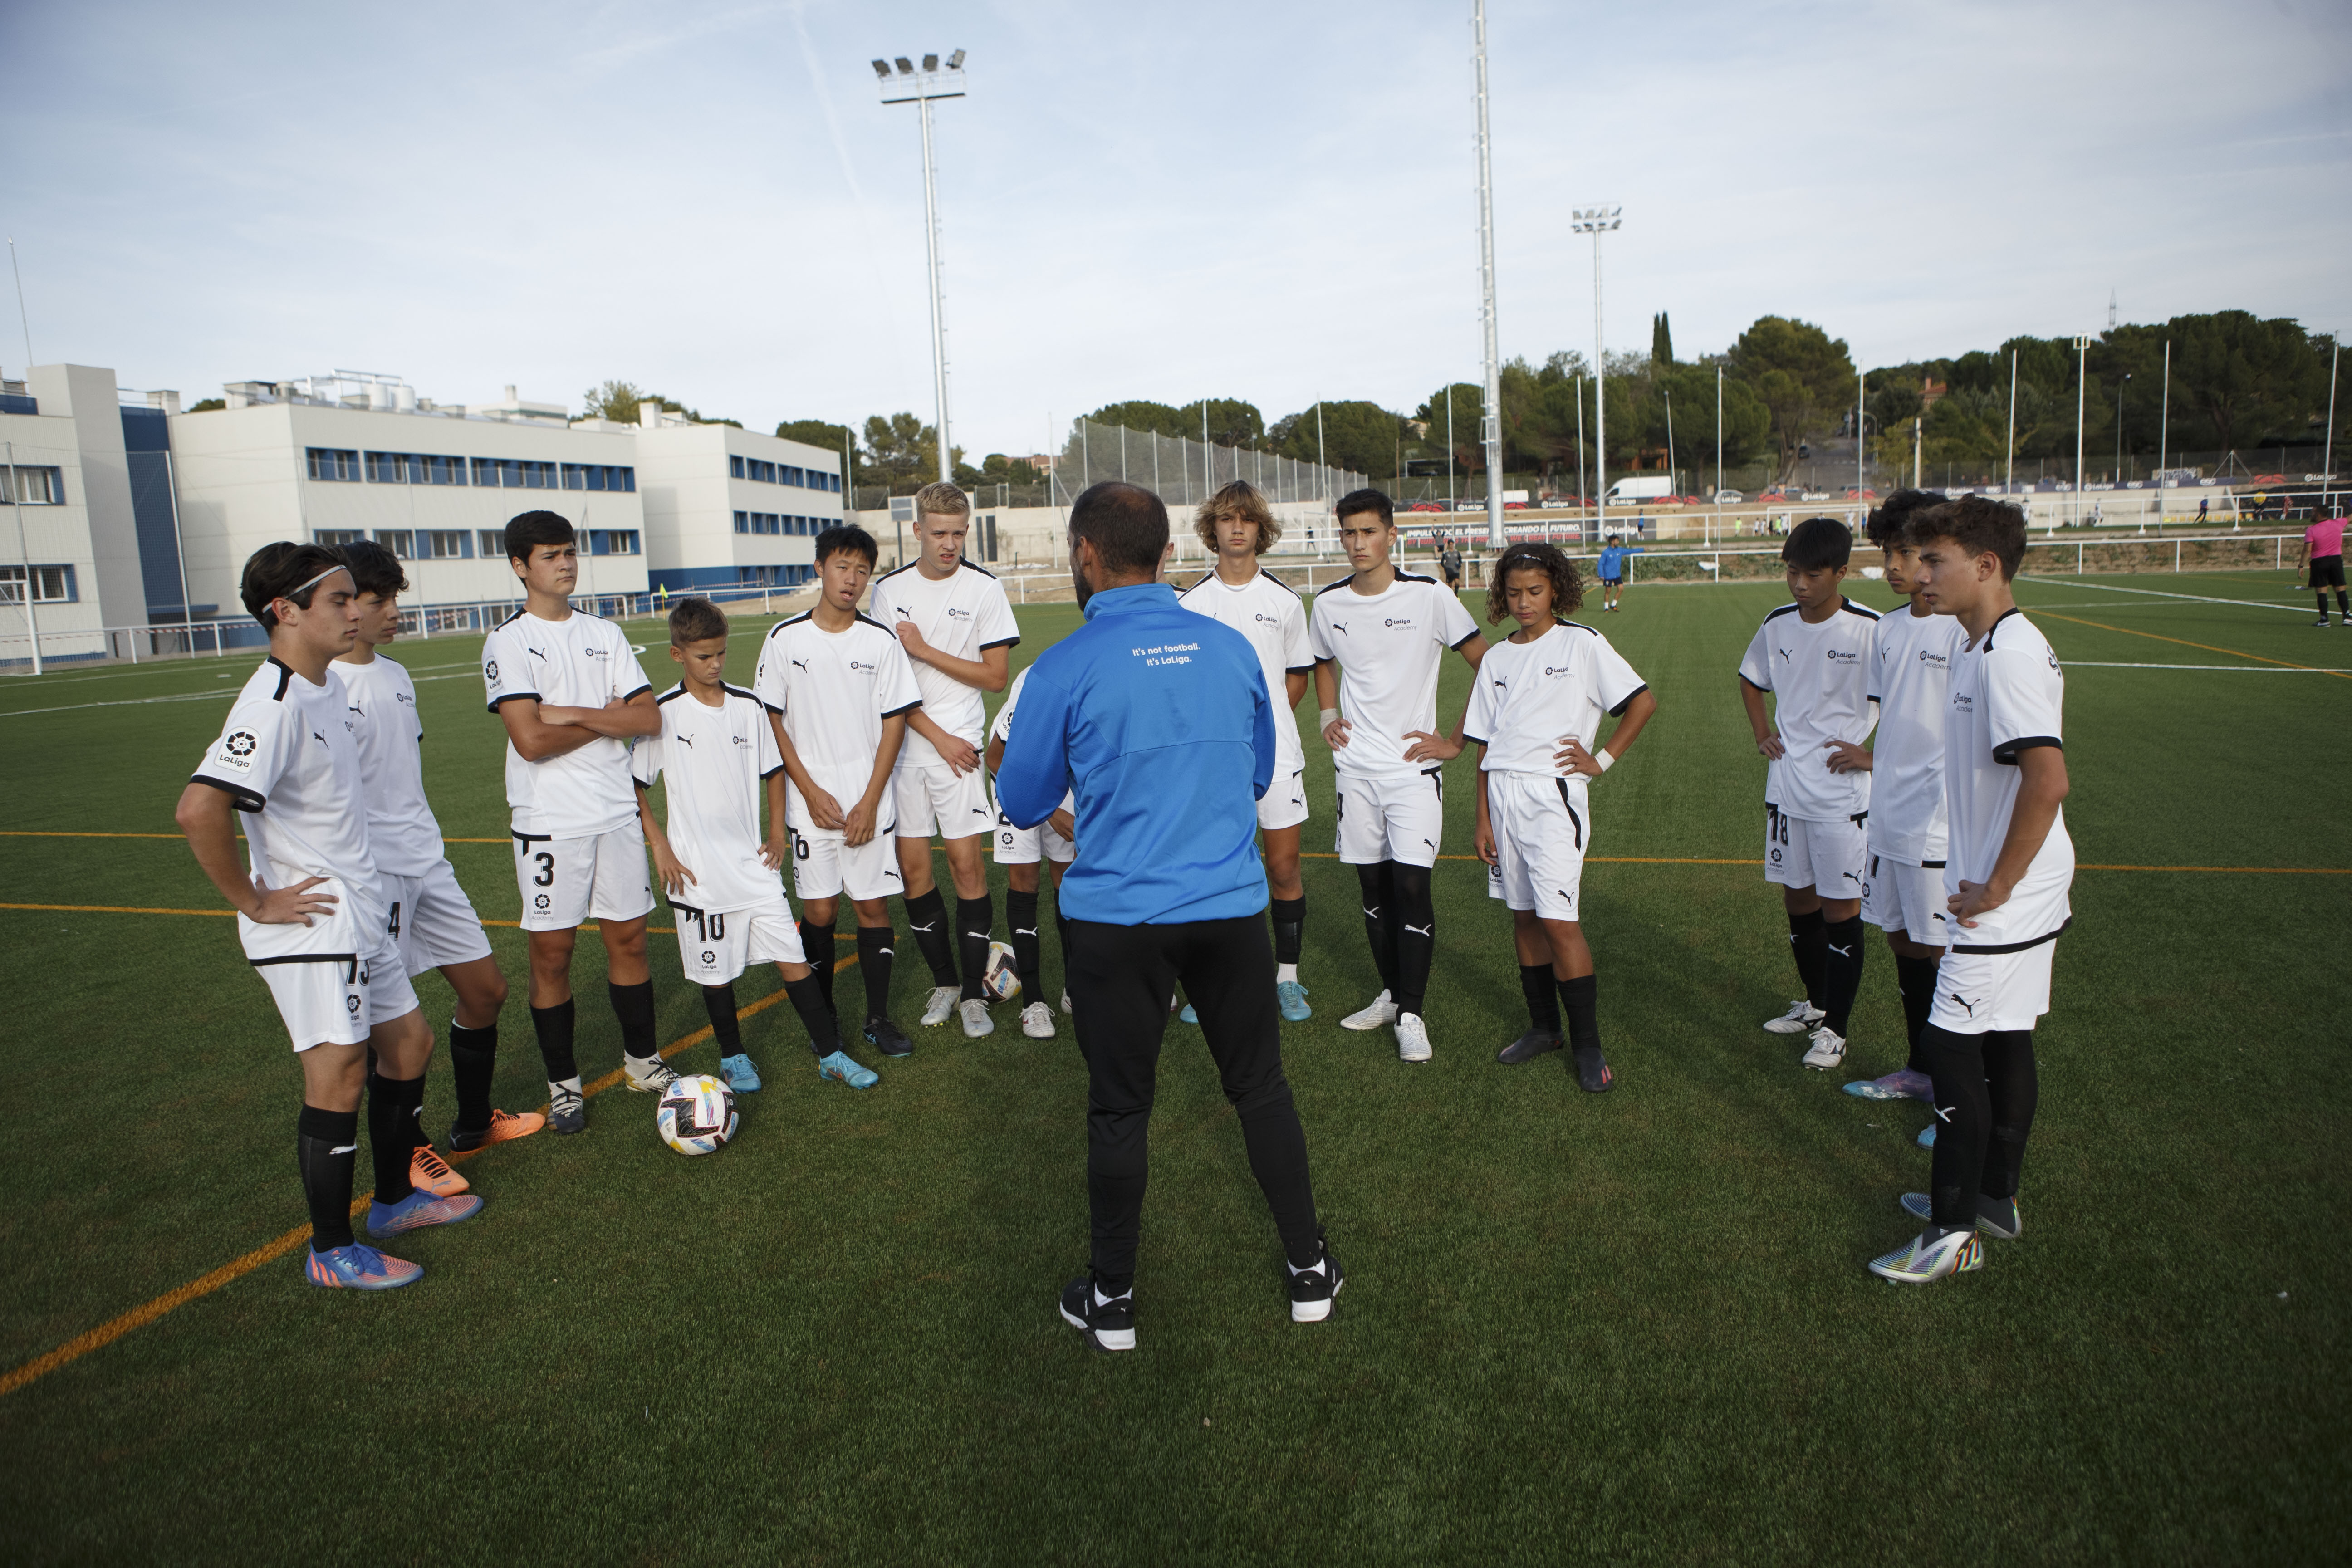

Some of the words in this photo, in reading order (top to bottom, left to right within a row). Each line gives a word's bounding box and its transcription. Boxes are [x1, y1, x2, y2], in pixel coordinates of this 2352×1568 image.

[1722, 495, 1742, 504] LaLiga
[1809, 492, 1830, 501] LaLiga
[1504, 525, 1539, 533] CREANDO
[1148, 647, 1162, 655] not
[1164, 642, 1201, 653] football.
[1161, 656, 1192, 665] LaLiga.
[1927, 653, 1946, 662] LaLiga
[490, 679, 502, 689] LaLiga
[219, 754, 250, 767] LaLiga
[1768, 809, 1788, 846] 18
[533, 852, 554, 888] 3
[693, 913, 725, 943] 10
